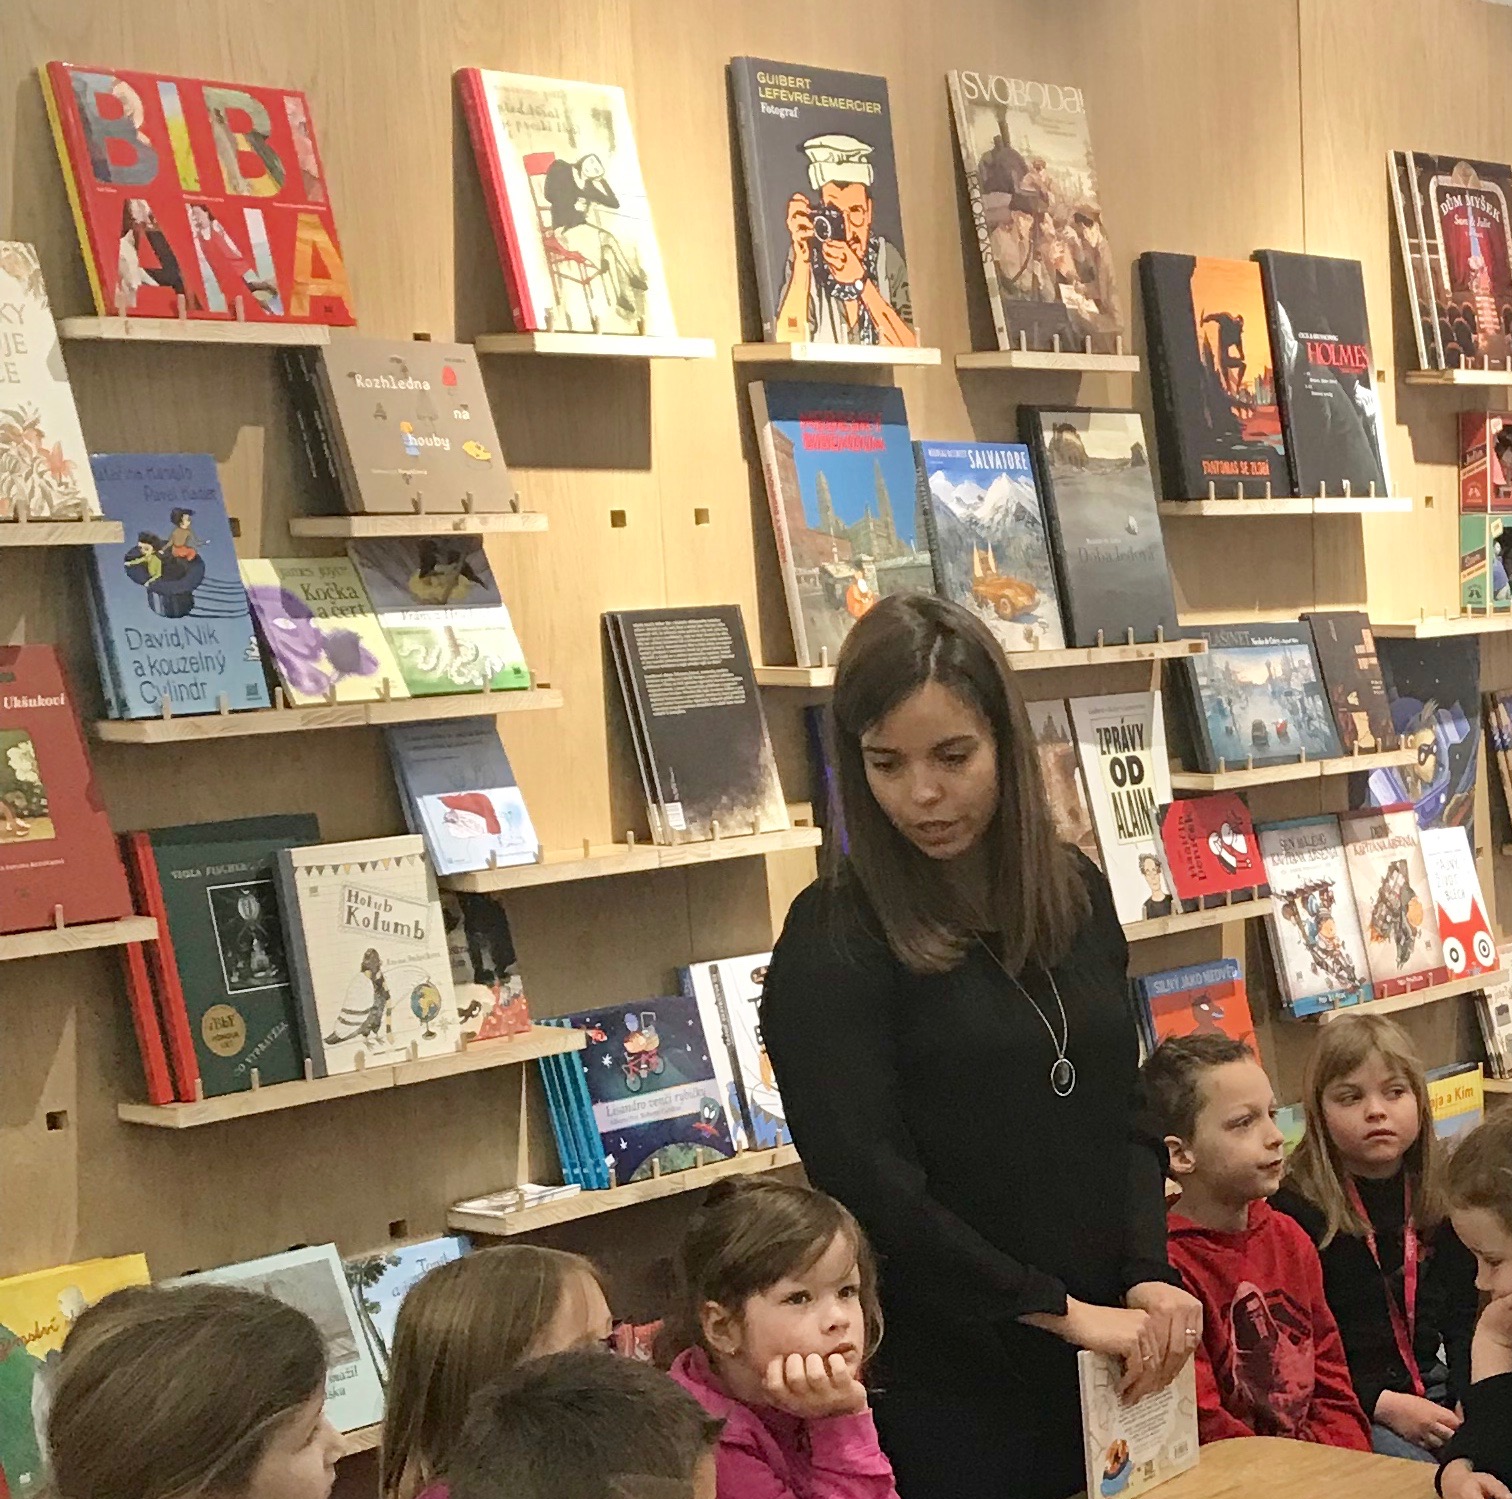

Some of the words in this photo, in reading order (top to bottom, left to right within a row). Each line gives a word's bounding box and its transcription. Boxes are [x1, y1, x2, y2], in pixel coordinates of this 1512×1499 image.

[757, 71, 811, 90] GUIBERT
[760, 102, 798, 119] Fotograf
[1440, 193, 1463, 216] DŮM
[1465, 194, 1501, 222] MYŠEK
[1306, 341, 1369, 369] HOLMES
[354, 373, 431, 391] Rozhledna
[453, 409, 470, 419] na
[407, 433, 451, 451] houby
[968, 449, 1029, 471] SALVATORE
[300, 582, 360, 602] Kočka
[318, 606, 328, 619] a
[331, 600, 368, 619] čert
[184, 624, 220, 647] Nik
[132, 660, 146, 677] a
[147, 650, 226, 678] kouzelný
[1096, 717, 1144, 756] ZPRÁVY
[1109, 755, 1145, 788] OD
[346, 889, 393, 913] Holub
[344, 905, 425, 941] Kolumb
[1446, 1095, 1453, 1104] a
[1454, 1085, 1475, 1104] Kim
